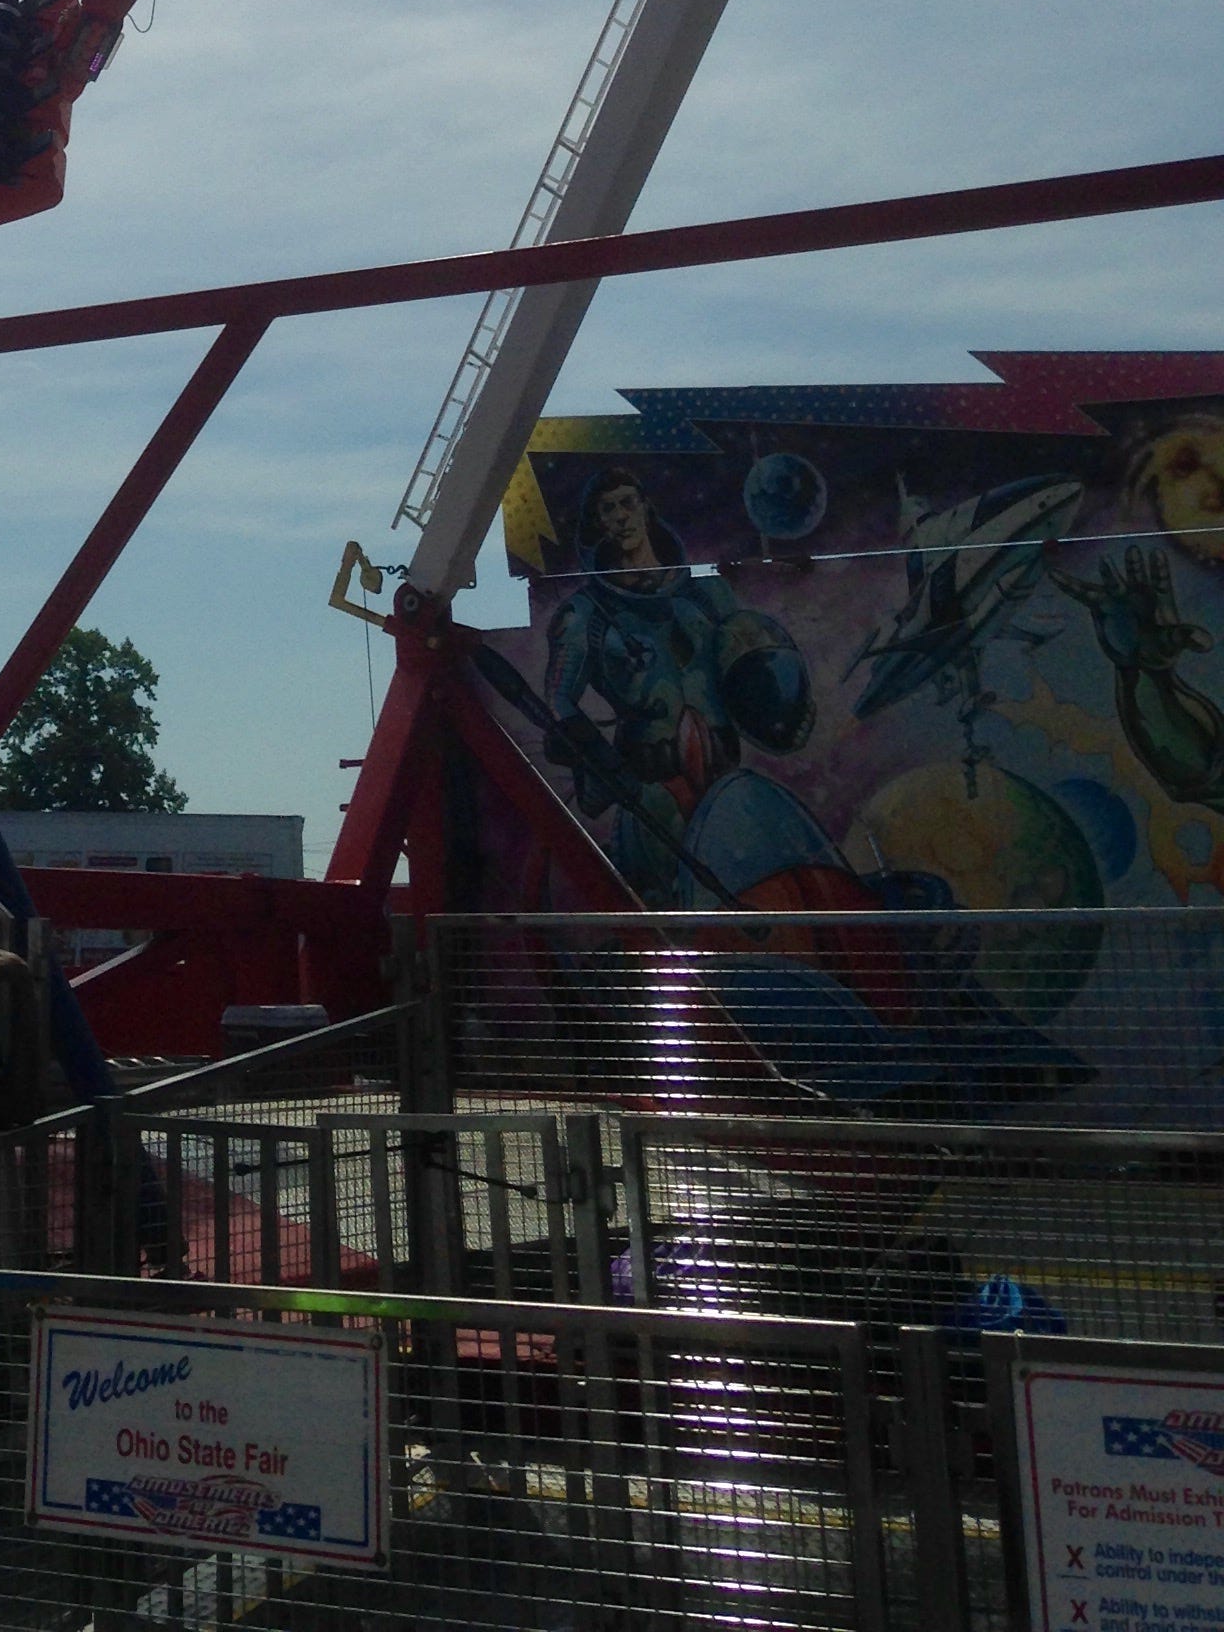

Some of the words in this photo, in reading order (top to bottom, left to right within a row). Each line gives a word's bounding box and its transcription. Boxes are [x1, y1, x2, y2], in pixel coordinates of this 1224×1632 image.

[62, 1355, 193, 1410] Welcome
[175, 1400, 193, 1420] to
[199, 1400, 229, 1425] the
[116, 1428, 170, 1461] Ohio
[178, 1435, 236, 1469] State
[245, 1443, 289, 1475] Fair
[1052, 1478, 1123, 1500] Patrons
[1129, 1484, 1176, 1503] Must
[1068, 1500, 1098, 1518] For
[1105, 1504, 1206, 1526] Admission
[1095, 1543, 1143, 1565] Ability
[1148, 1548, 1164, 1563] to
[1096, 1563, 1152, 1581] control
[1156, 1570, 1204, 1584] under
[1099, 1597, 1148, 1619] Ability
[1153, 1602, 1169, 1617] to
